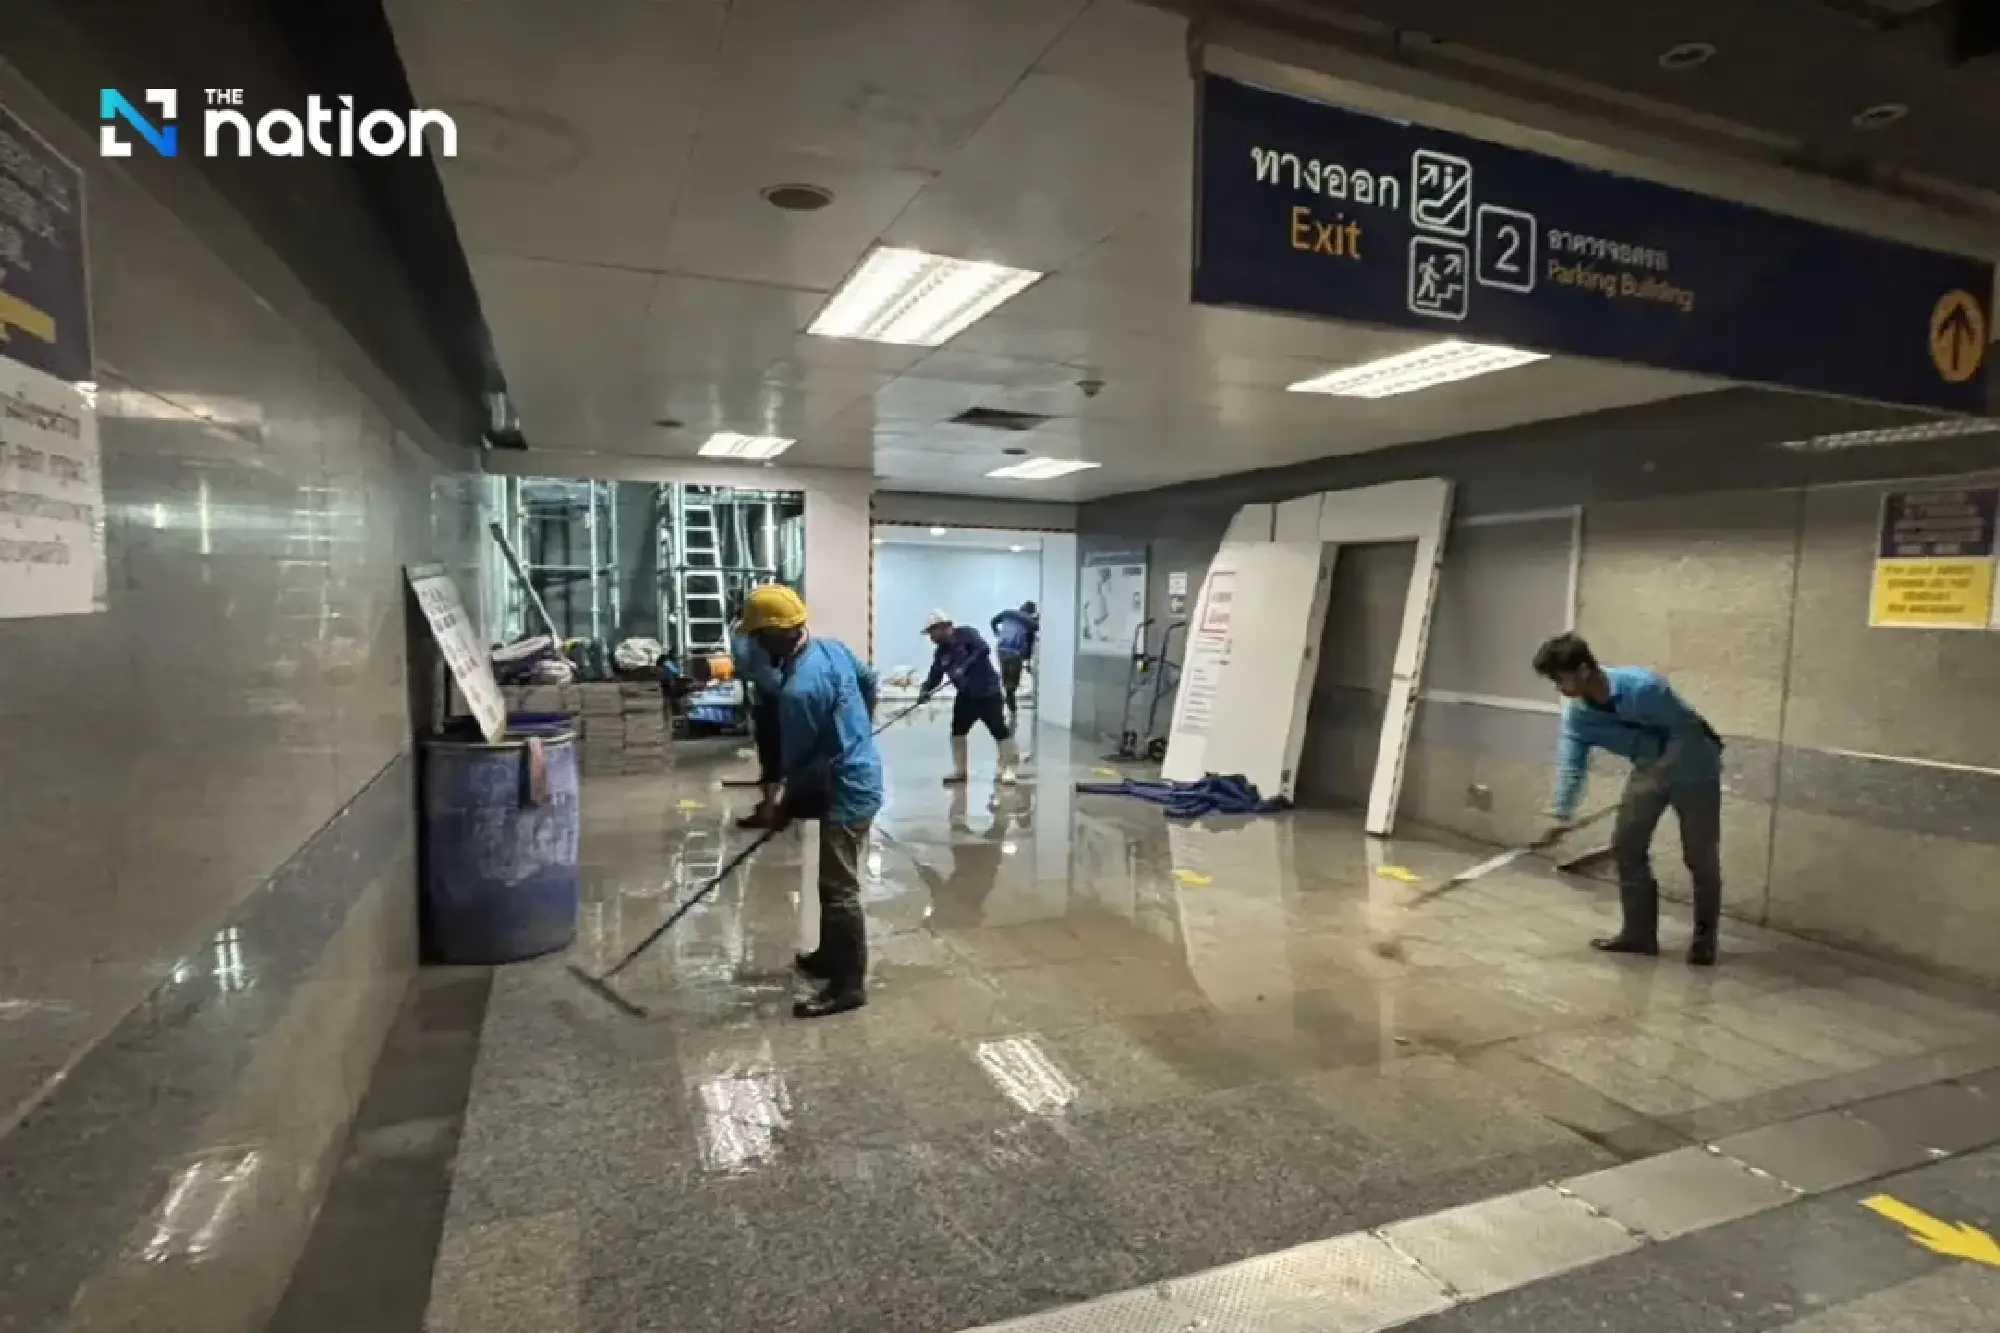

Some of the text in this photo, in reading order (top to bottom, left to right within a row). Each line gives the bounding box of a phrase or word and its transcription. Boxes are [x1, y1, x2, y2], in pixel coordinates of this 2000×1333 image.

[1250, 144, 1400, 209] ทางออก
[1291, 206, 1363, 261] Exit
[1496, 225, 1521, 273] 2
[1547, 258, 1695, 312] Parking Building
